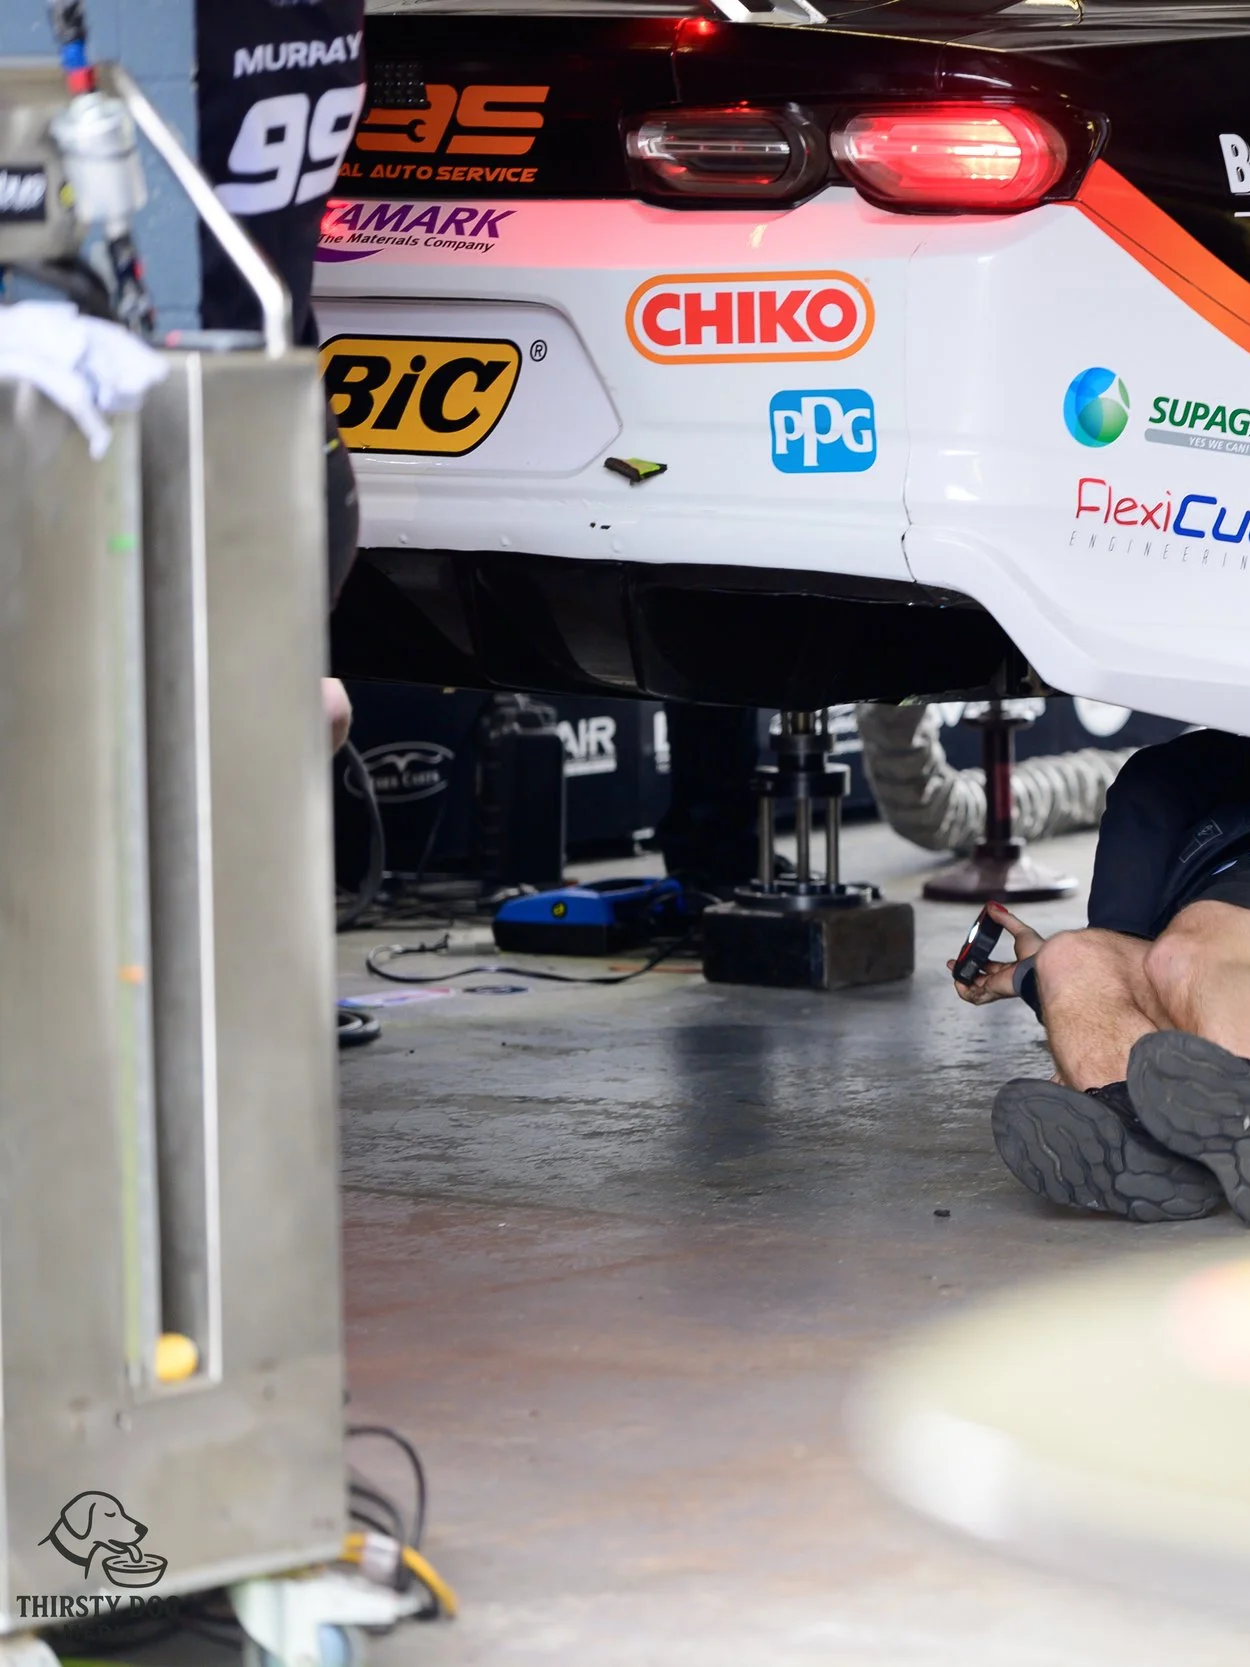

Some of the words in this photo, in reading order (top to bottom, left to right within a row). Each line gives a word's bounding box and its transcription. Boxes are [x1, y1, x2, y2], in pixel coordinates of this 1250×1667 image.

[233, 30, 363, 79] MURRAY
[213, 82, 367, 215] 99
[369, 164, 434, 181] AUTO
[434, 165, 539, 183] SERVICE
[317, 232, 344, 244] The
[346, 232, 420, 247] Materials
[423, 236, 496, 253] Company
[641, 288, 858, 347] CHIKO
[772, 396, 874, 467] PPG
[1188, 435, 1206, 448] YES
[1207, 438, 1224, 450] WE
[1224, 441, 1250, 454] CAN!
